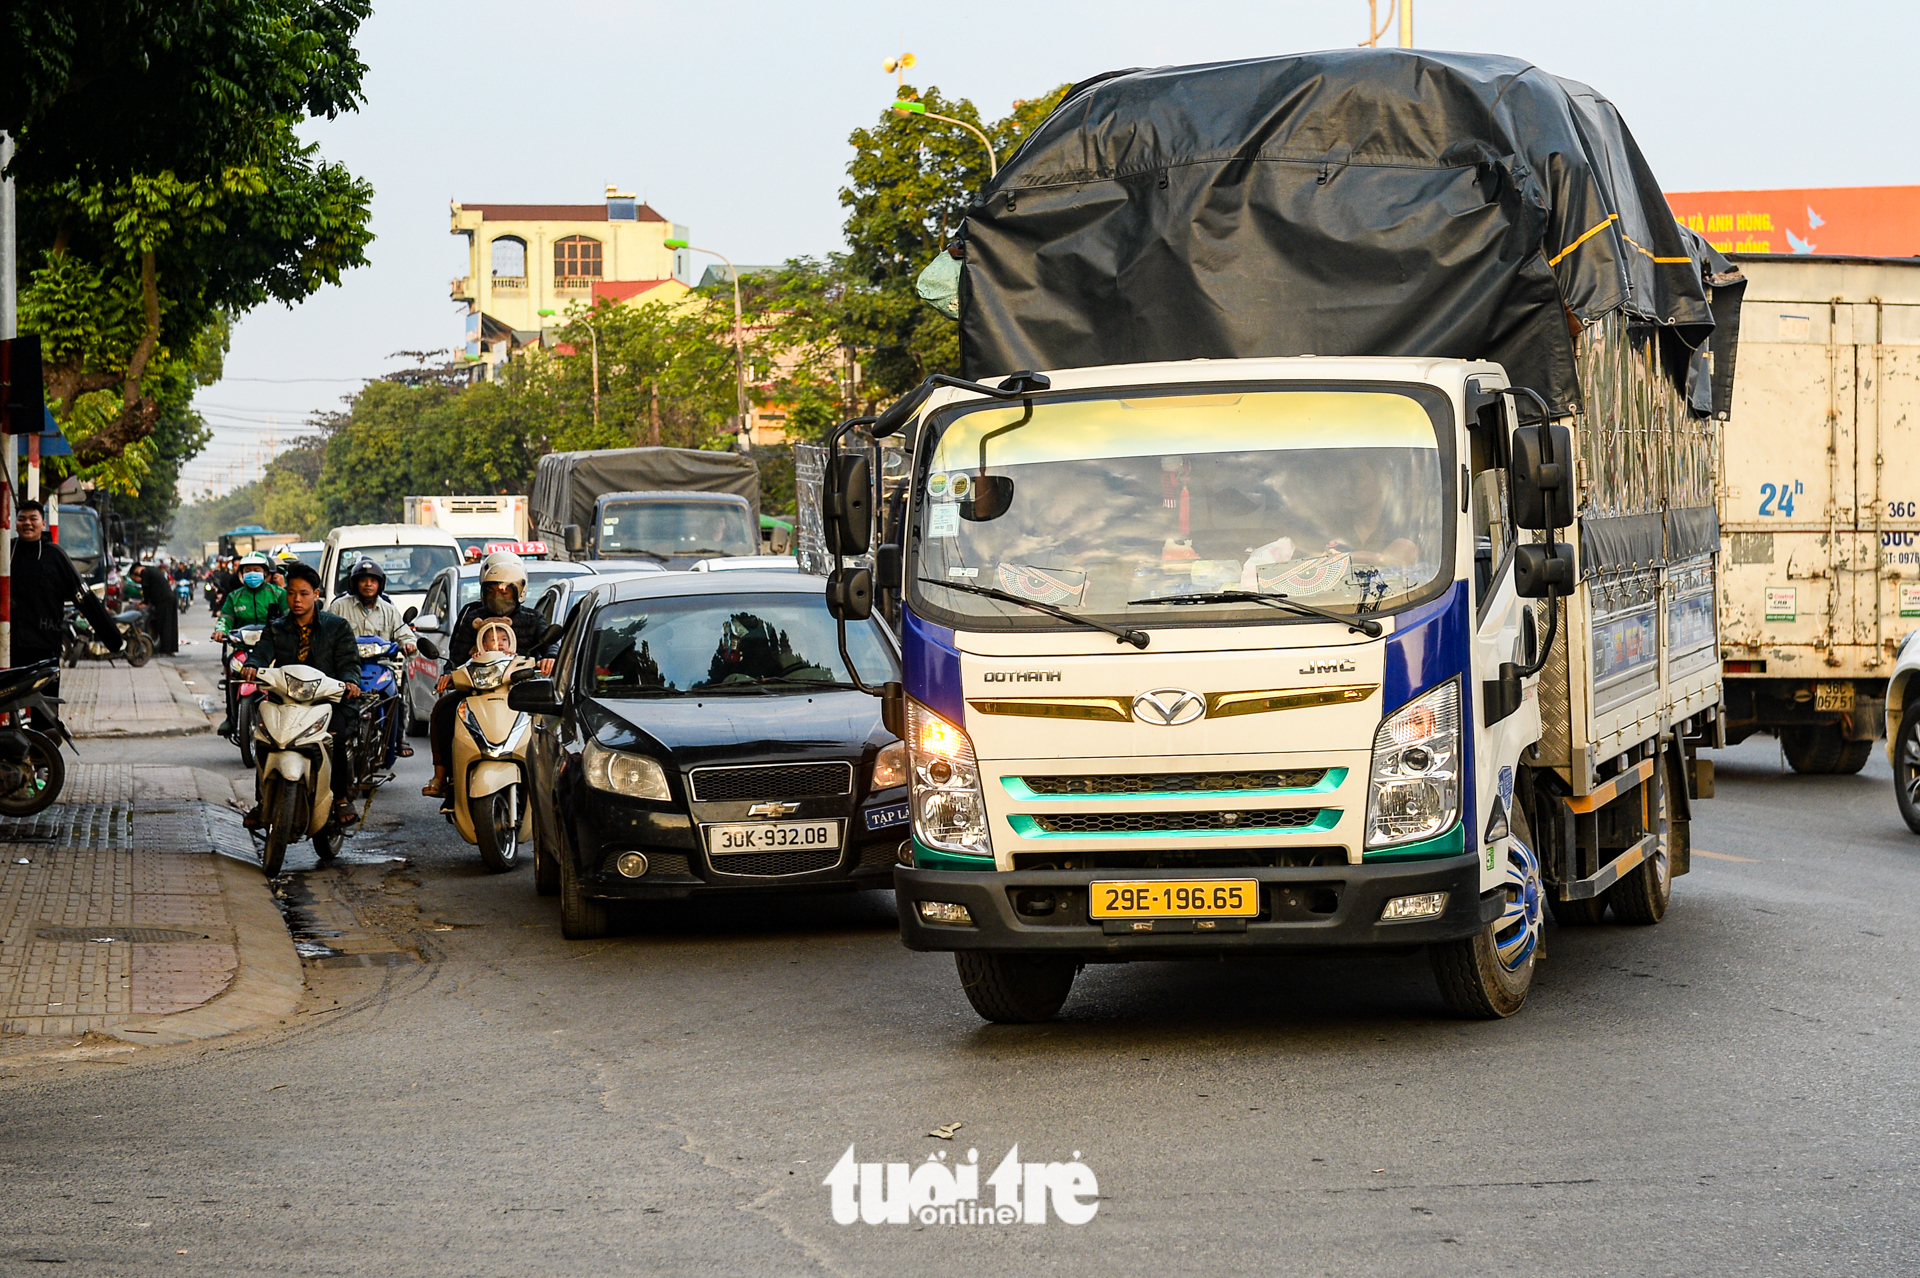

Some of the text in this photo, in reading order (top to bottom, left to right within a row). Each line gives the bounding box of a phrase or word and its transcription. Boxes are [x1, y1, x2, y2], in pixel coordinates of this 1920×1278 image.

[1707, 214, 1733, 232] ANH
[1737, 210, 1774, 233] HÙNG,
[1759, 479, 1803, 517] 24h
[1888, 502, 1916, 518] 36C
[489, 543, 545, 553] Taxi 123
[1299, 659, 1356, 675] JMC
[871, 806, 910, 825] TẬP LÁ
[721, 827, 828, 848] 30K-932.08
[1105, 887, 1243, 911] 29E-196.65
